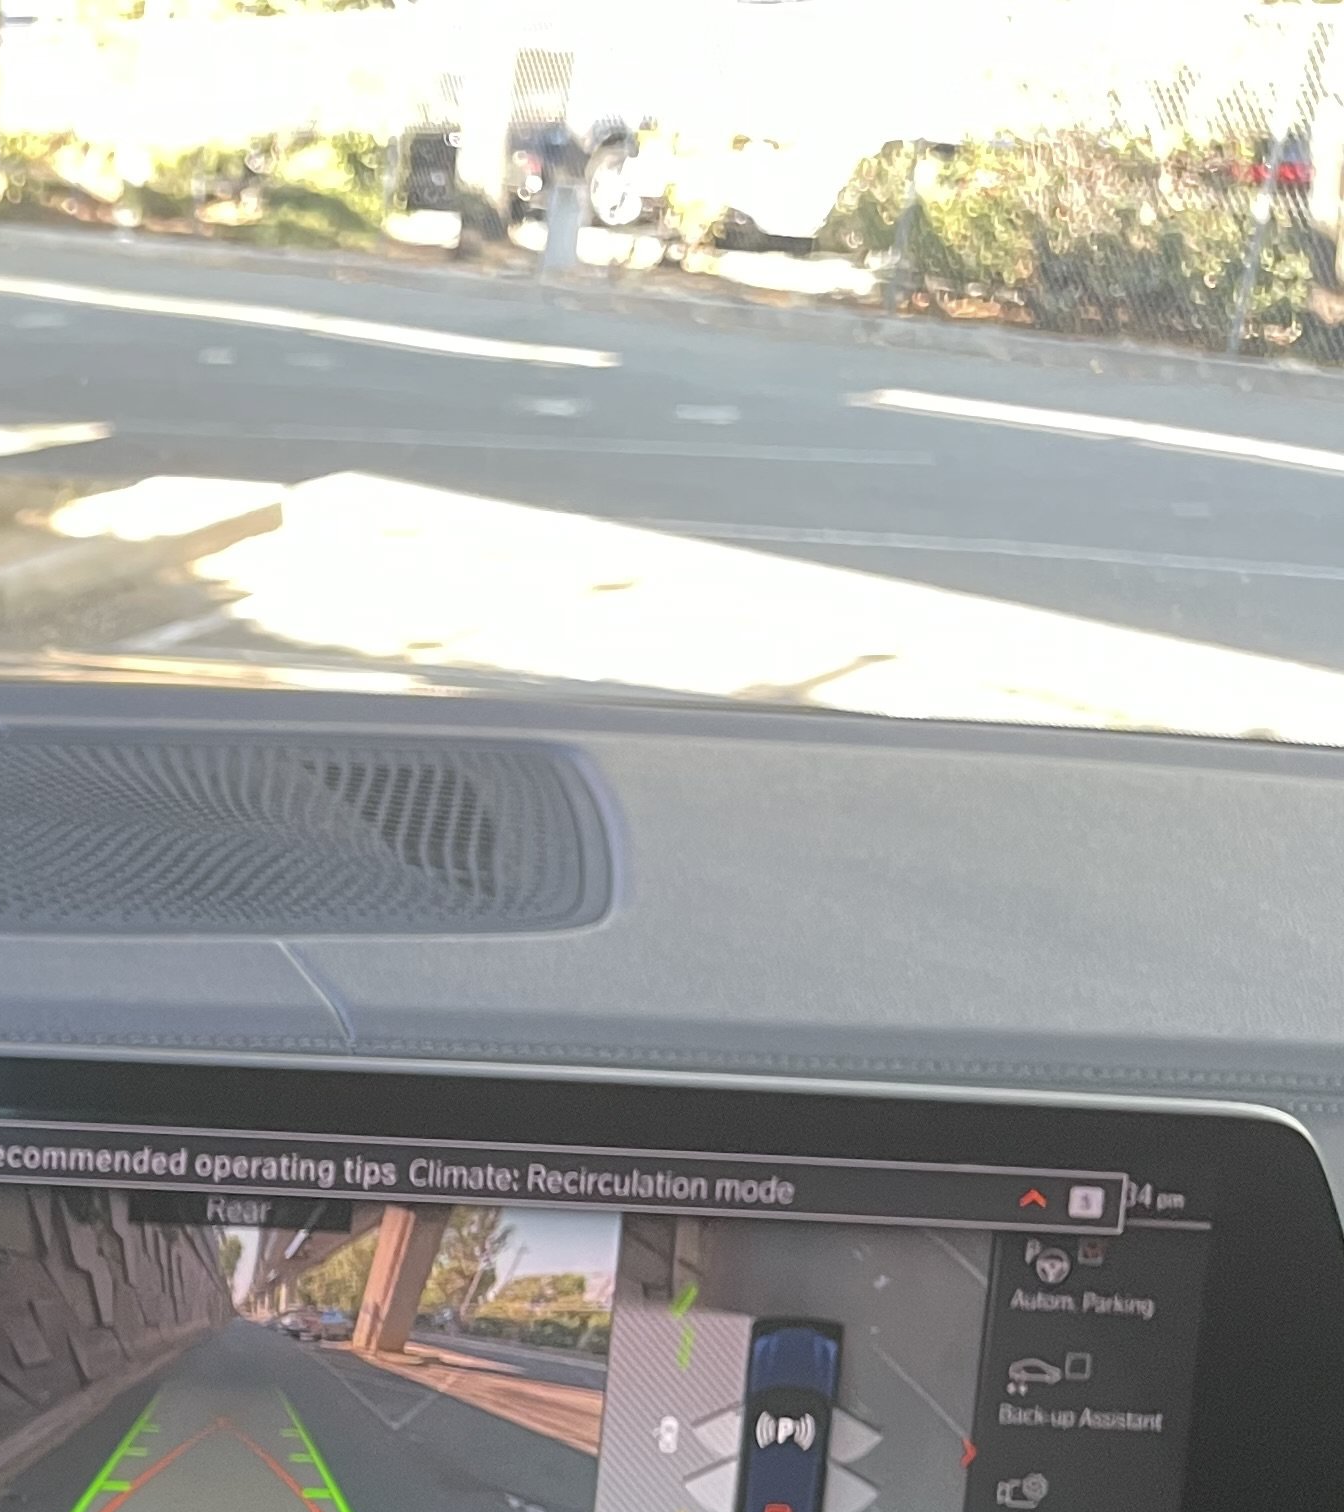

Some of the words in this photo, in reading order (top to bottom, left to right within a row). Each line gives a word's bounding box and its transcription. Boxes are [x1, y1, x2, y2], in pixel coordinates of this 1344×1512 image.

[194, 1147, 334, 1188] operating
[343, 1153, 397, 1191] tips
[408, 1159, 519, 1193] Climate:
[526, 1163, 708, 1201] Recirculation
[716, 1174, 795, 1205] mode
[207, 1197, 272, 1224] Rear
[1082, 1291, 1156, 1320] Parking
[1079, 1407, 1163, 1433] Assistant
